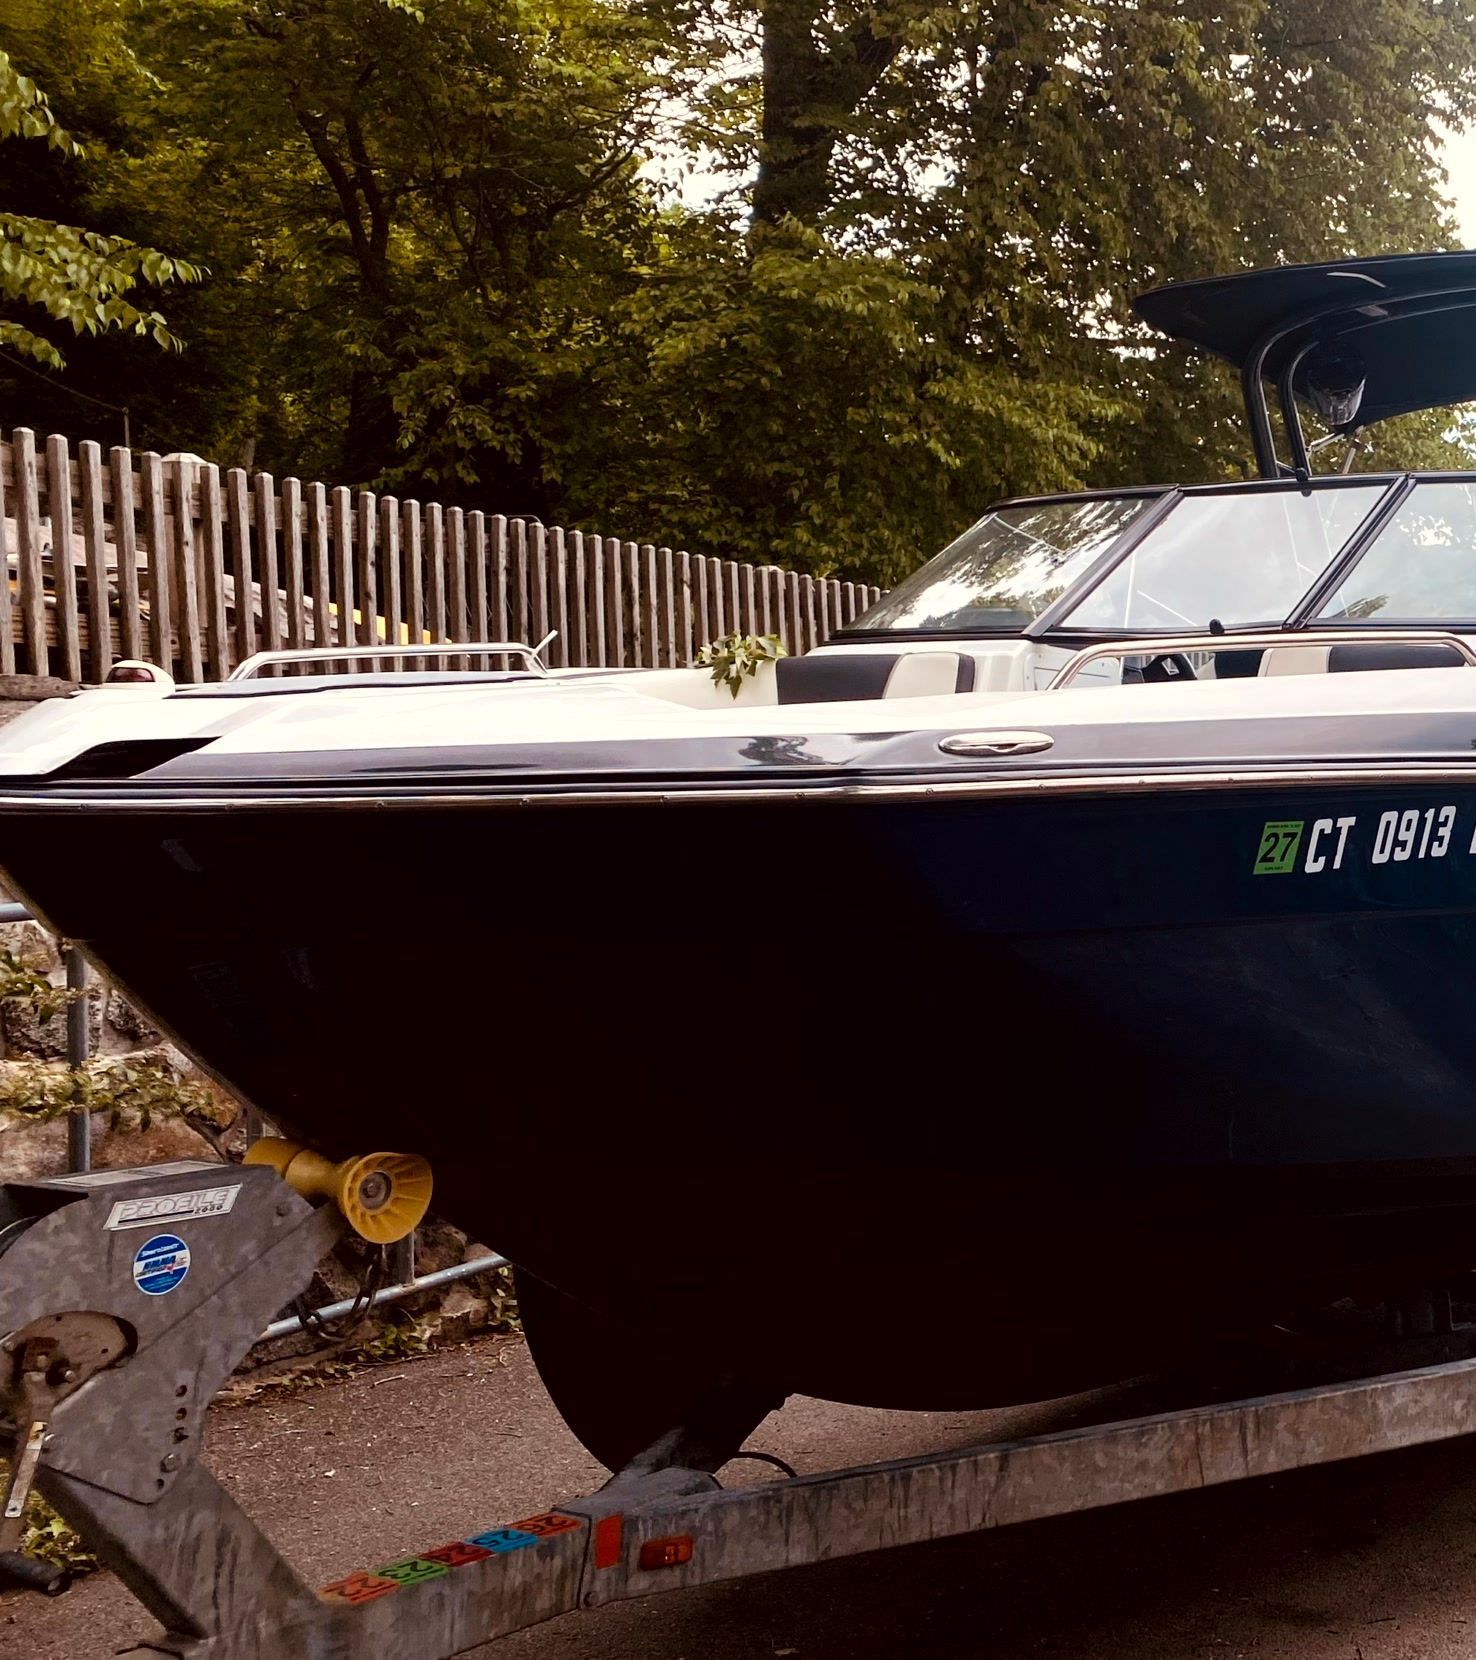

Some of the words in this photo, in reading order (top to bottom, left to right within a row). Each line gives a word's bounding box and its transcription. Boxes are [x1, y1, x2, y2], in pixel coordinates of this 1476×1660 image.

[1258, 832, 1298, 864] 27
[1304, 816, 1356, 874] CT
[1371, 805, 1456, 864] 0913
[120, 1189, 228, 1219] PROFILE
[378, 1561, 434, 1579] 23
